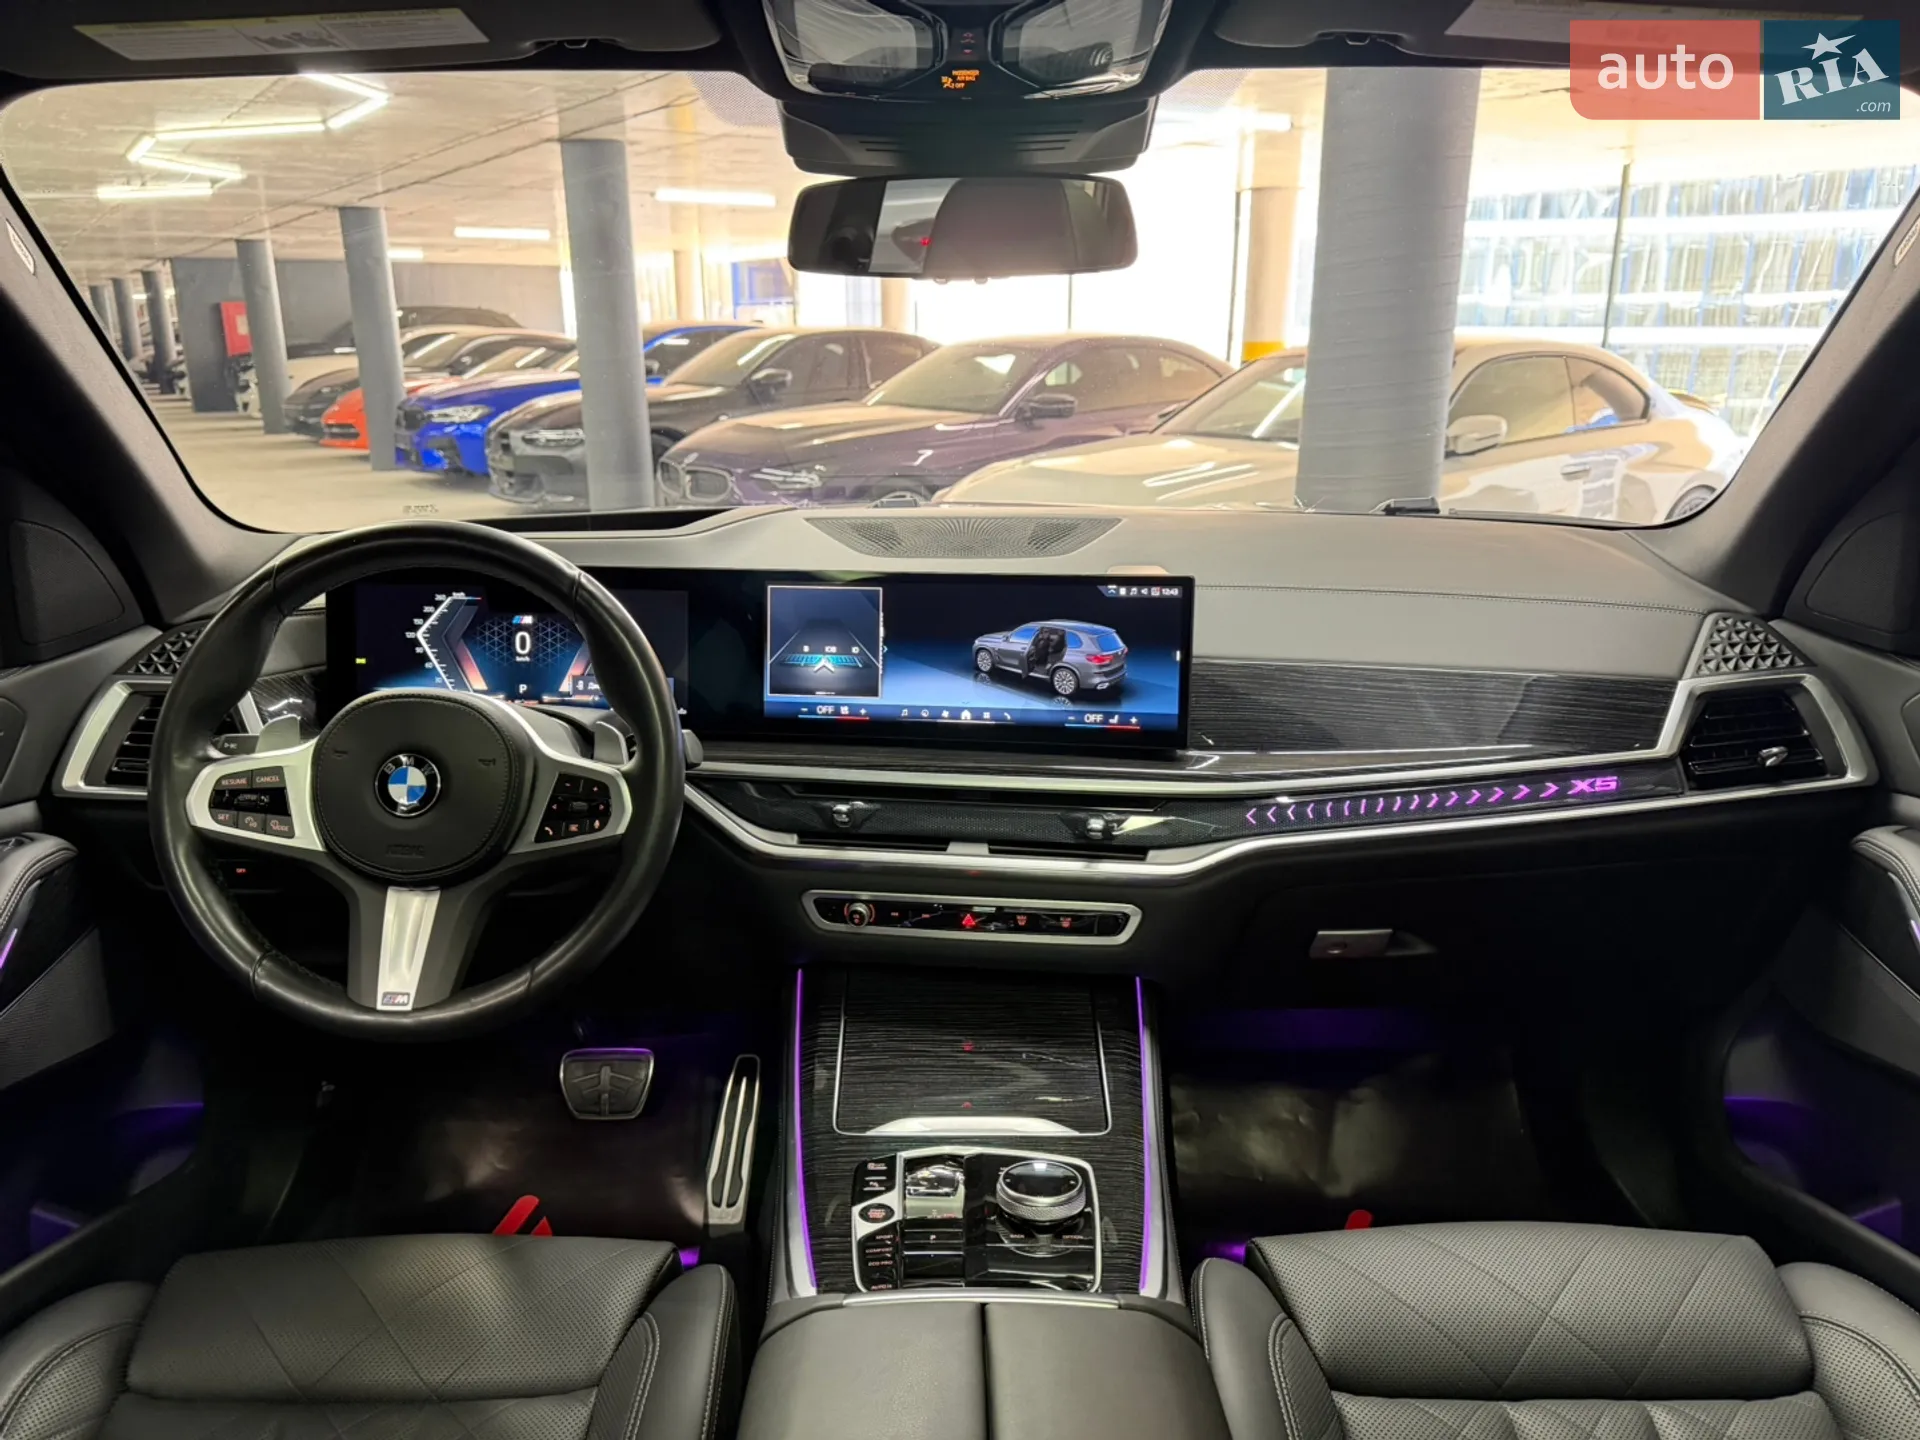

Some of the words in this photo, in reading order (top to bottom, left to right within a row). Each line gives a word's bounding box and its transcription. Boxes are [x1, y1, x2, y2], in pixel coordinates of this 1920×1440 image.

[514, 631, 531, 654] 0
[519, 684, 527, 693] P
[816, 705, 835, 715] OFF
[1084, 714, 1103, 723] OFF
[222, 778, 248, 786] RESUME
[256, 775, 280, 783] CANCEL
[1567, 776, 1618, 794] X5
